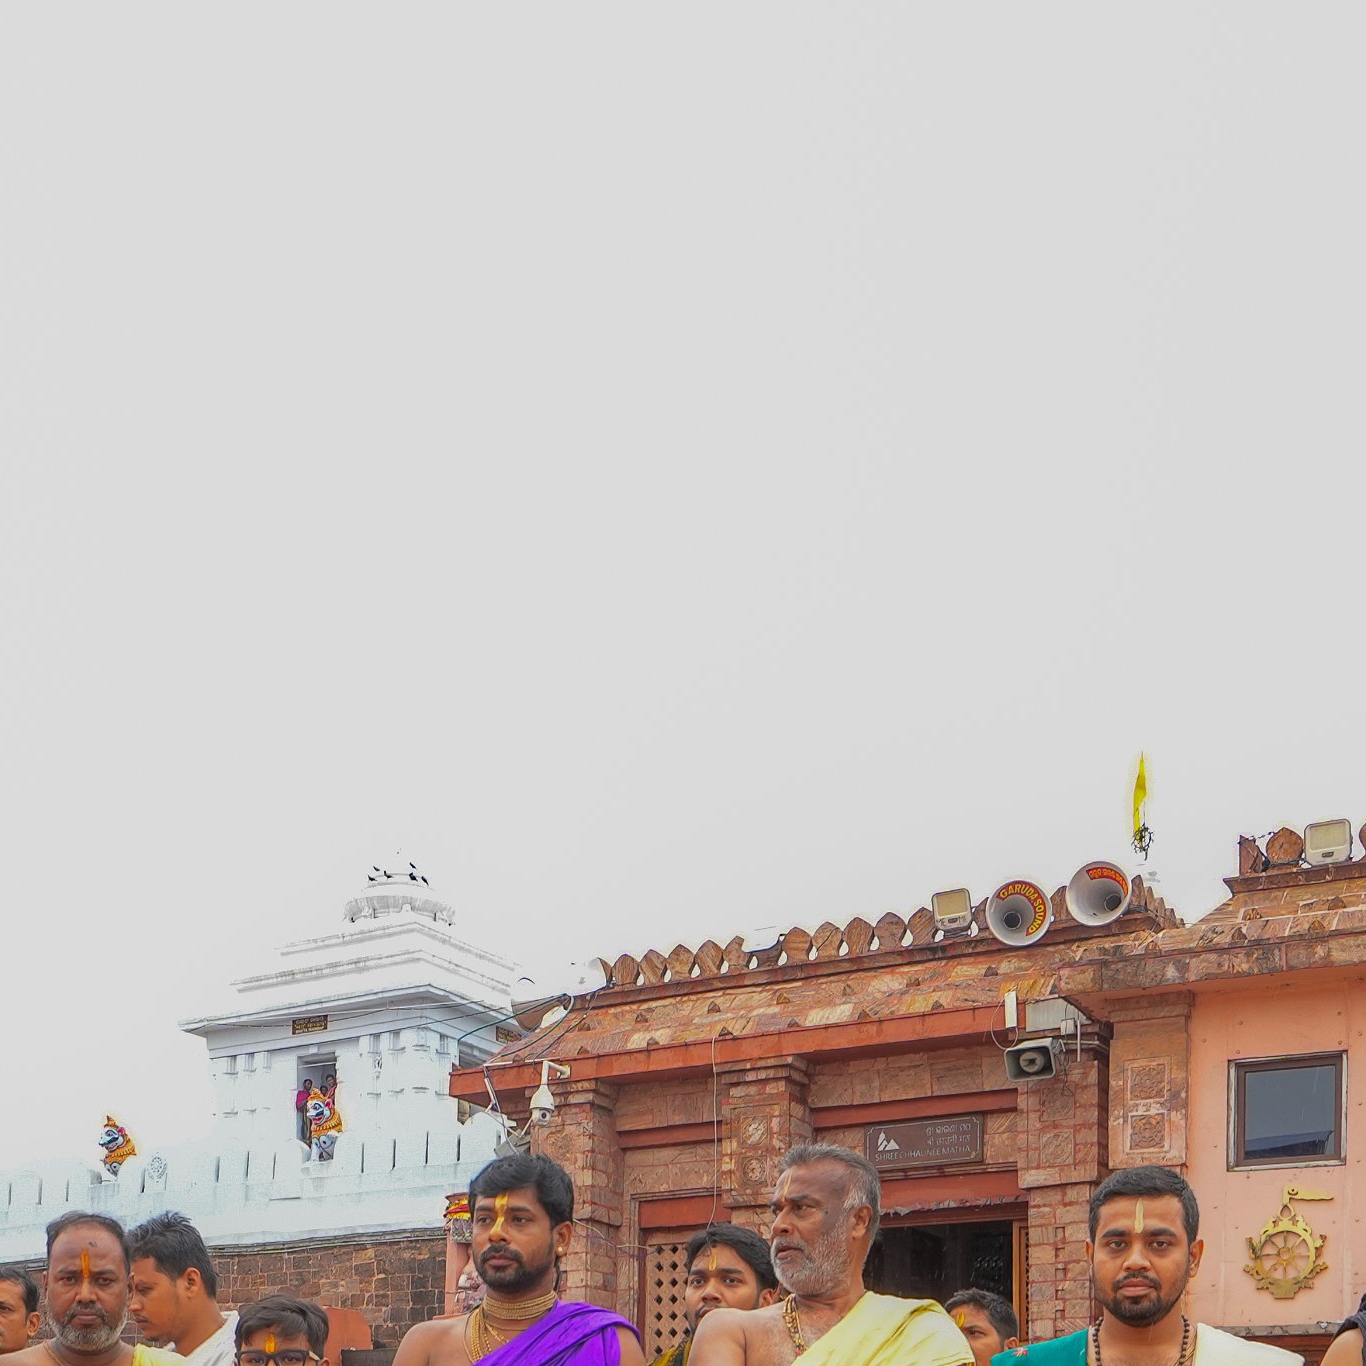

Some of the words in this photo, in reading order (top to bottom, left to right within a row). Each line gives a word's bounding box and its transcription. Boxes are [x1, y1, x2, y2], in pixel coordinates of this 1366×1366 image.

[999, 884, 1039, 899] GARUDA
[1028, 898, 1045, 933] SOUND
[875, 1151, 899, 1162] SHREE
[941, 1145, 971, 1154] MATHA
